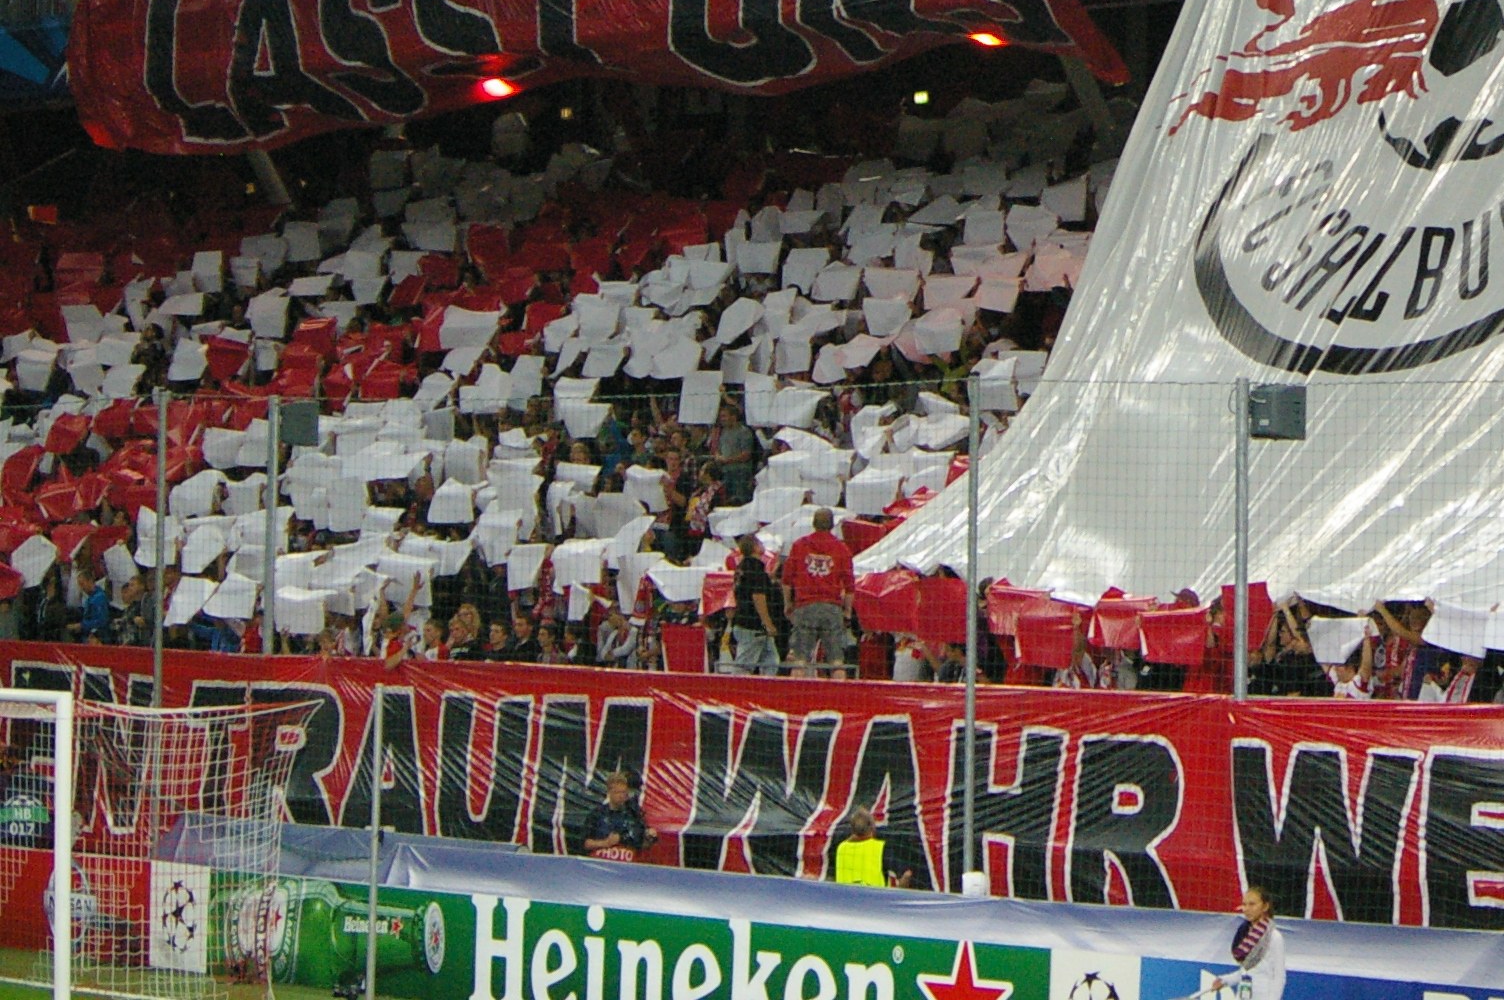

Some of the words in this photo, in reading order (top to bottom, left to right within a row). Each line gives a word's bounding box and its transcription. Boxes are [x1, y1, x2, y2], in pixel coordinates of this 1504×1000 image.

[186, 680, 657, 857] TRAUM
[679, 703, 1184, 910] WAHR
[469, 893, 894, 1000] Heineken
